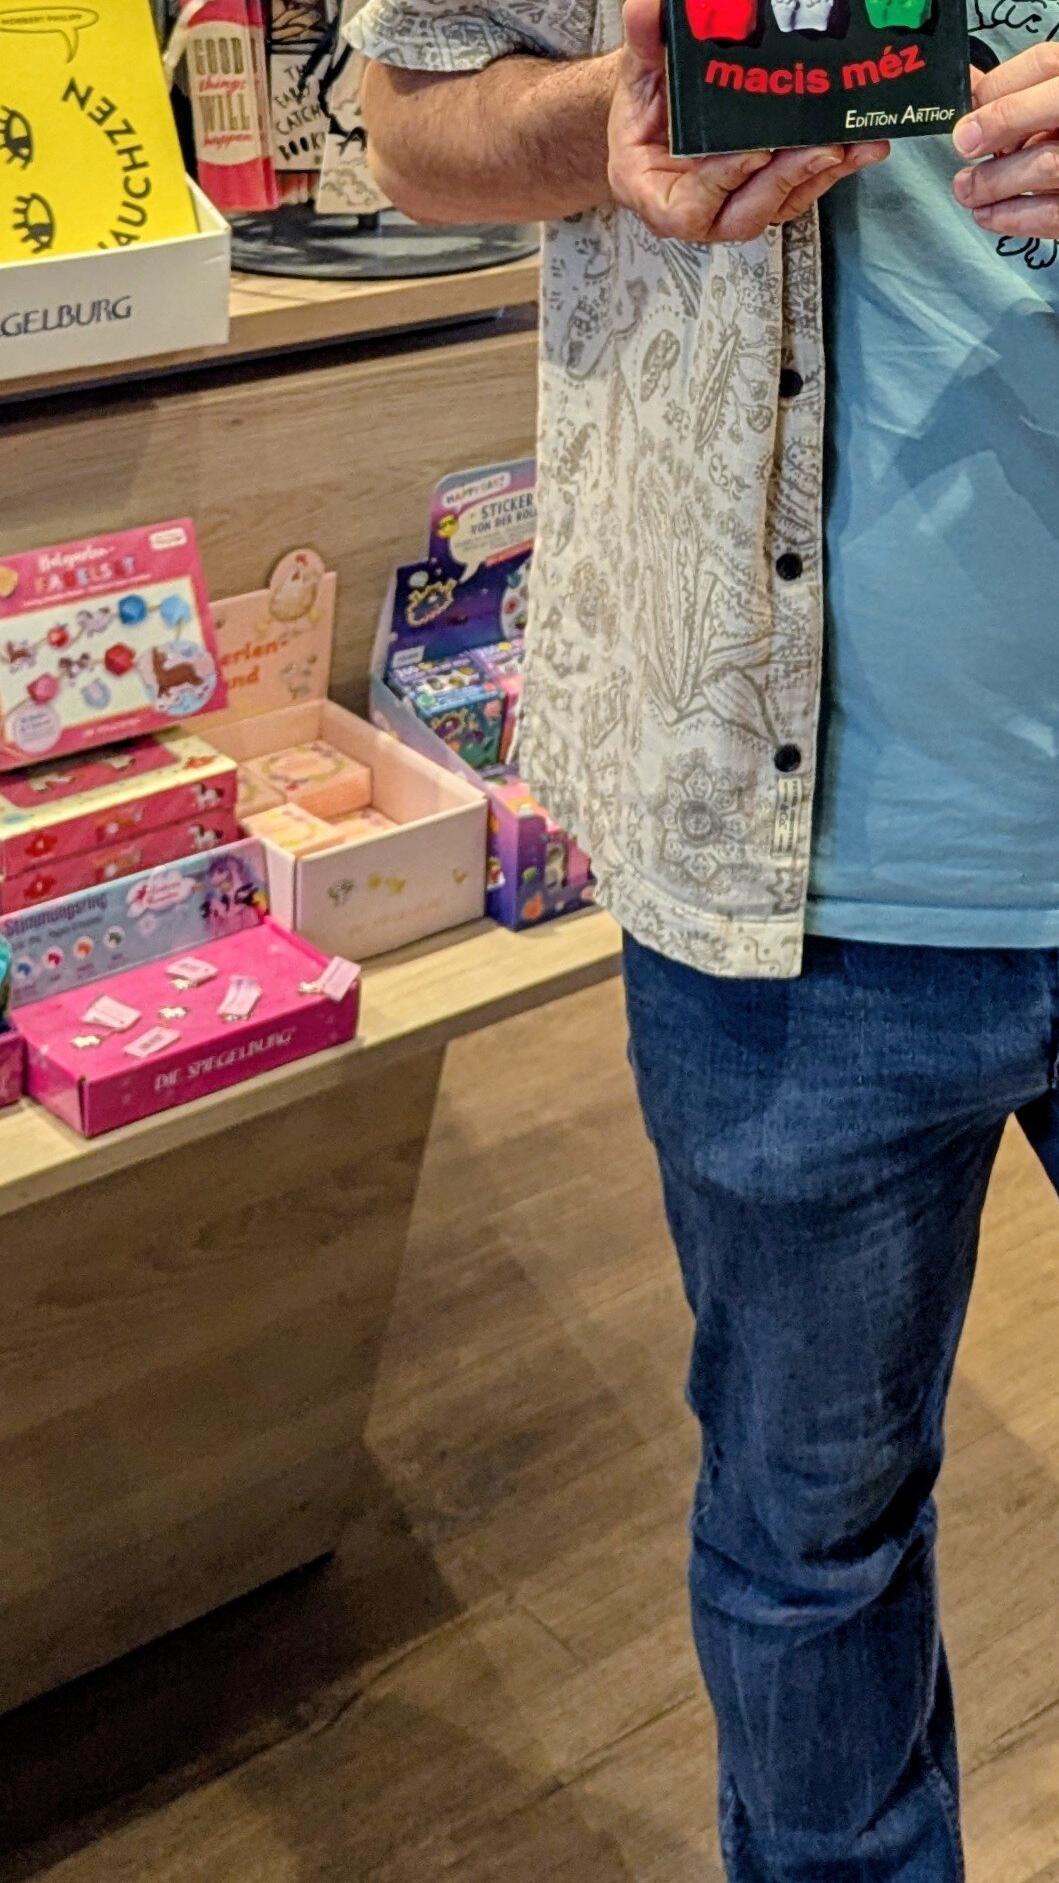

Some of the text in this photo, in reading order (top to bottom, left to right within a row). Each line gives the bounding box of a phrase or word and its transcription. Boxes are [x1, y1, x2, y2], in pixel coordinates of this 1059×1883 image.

[193, 37, 246, 75] GOOD
[704, 44, 926, 96] macis méz
[200, 92, 251, 132] WILL
[61, 76, 151, 249] AUCHZEN
